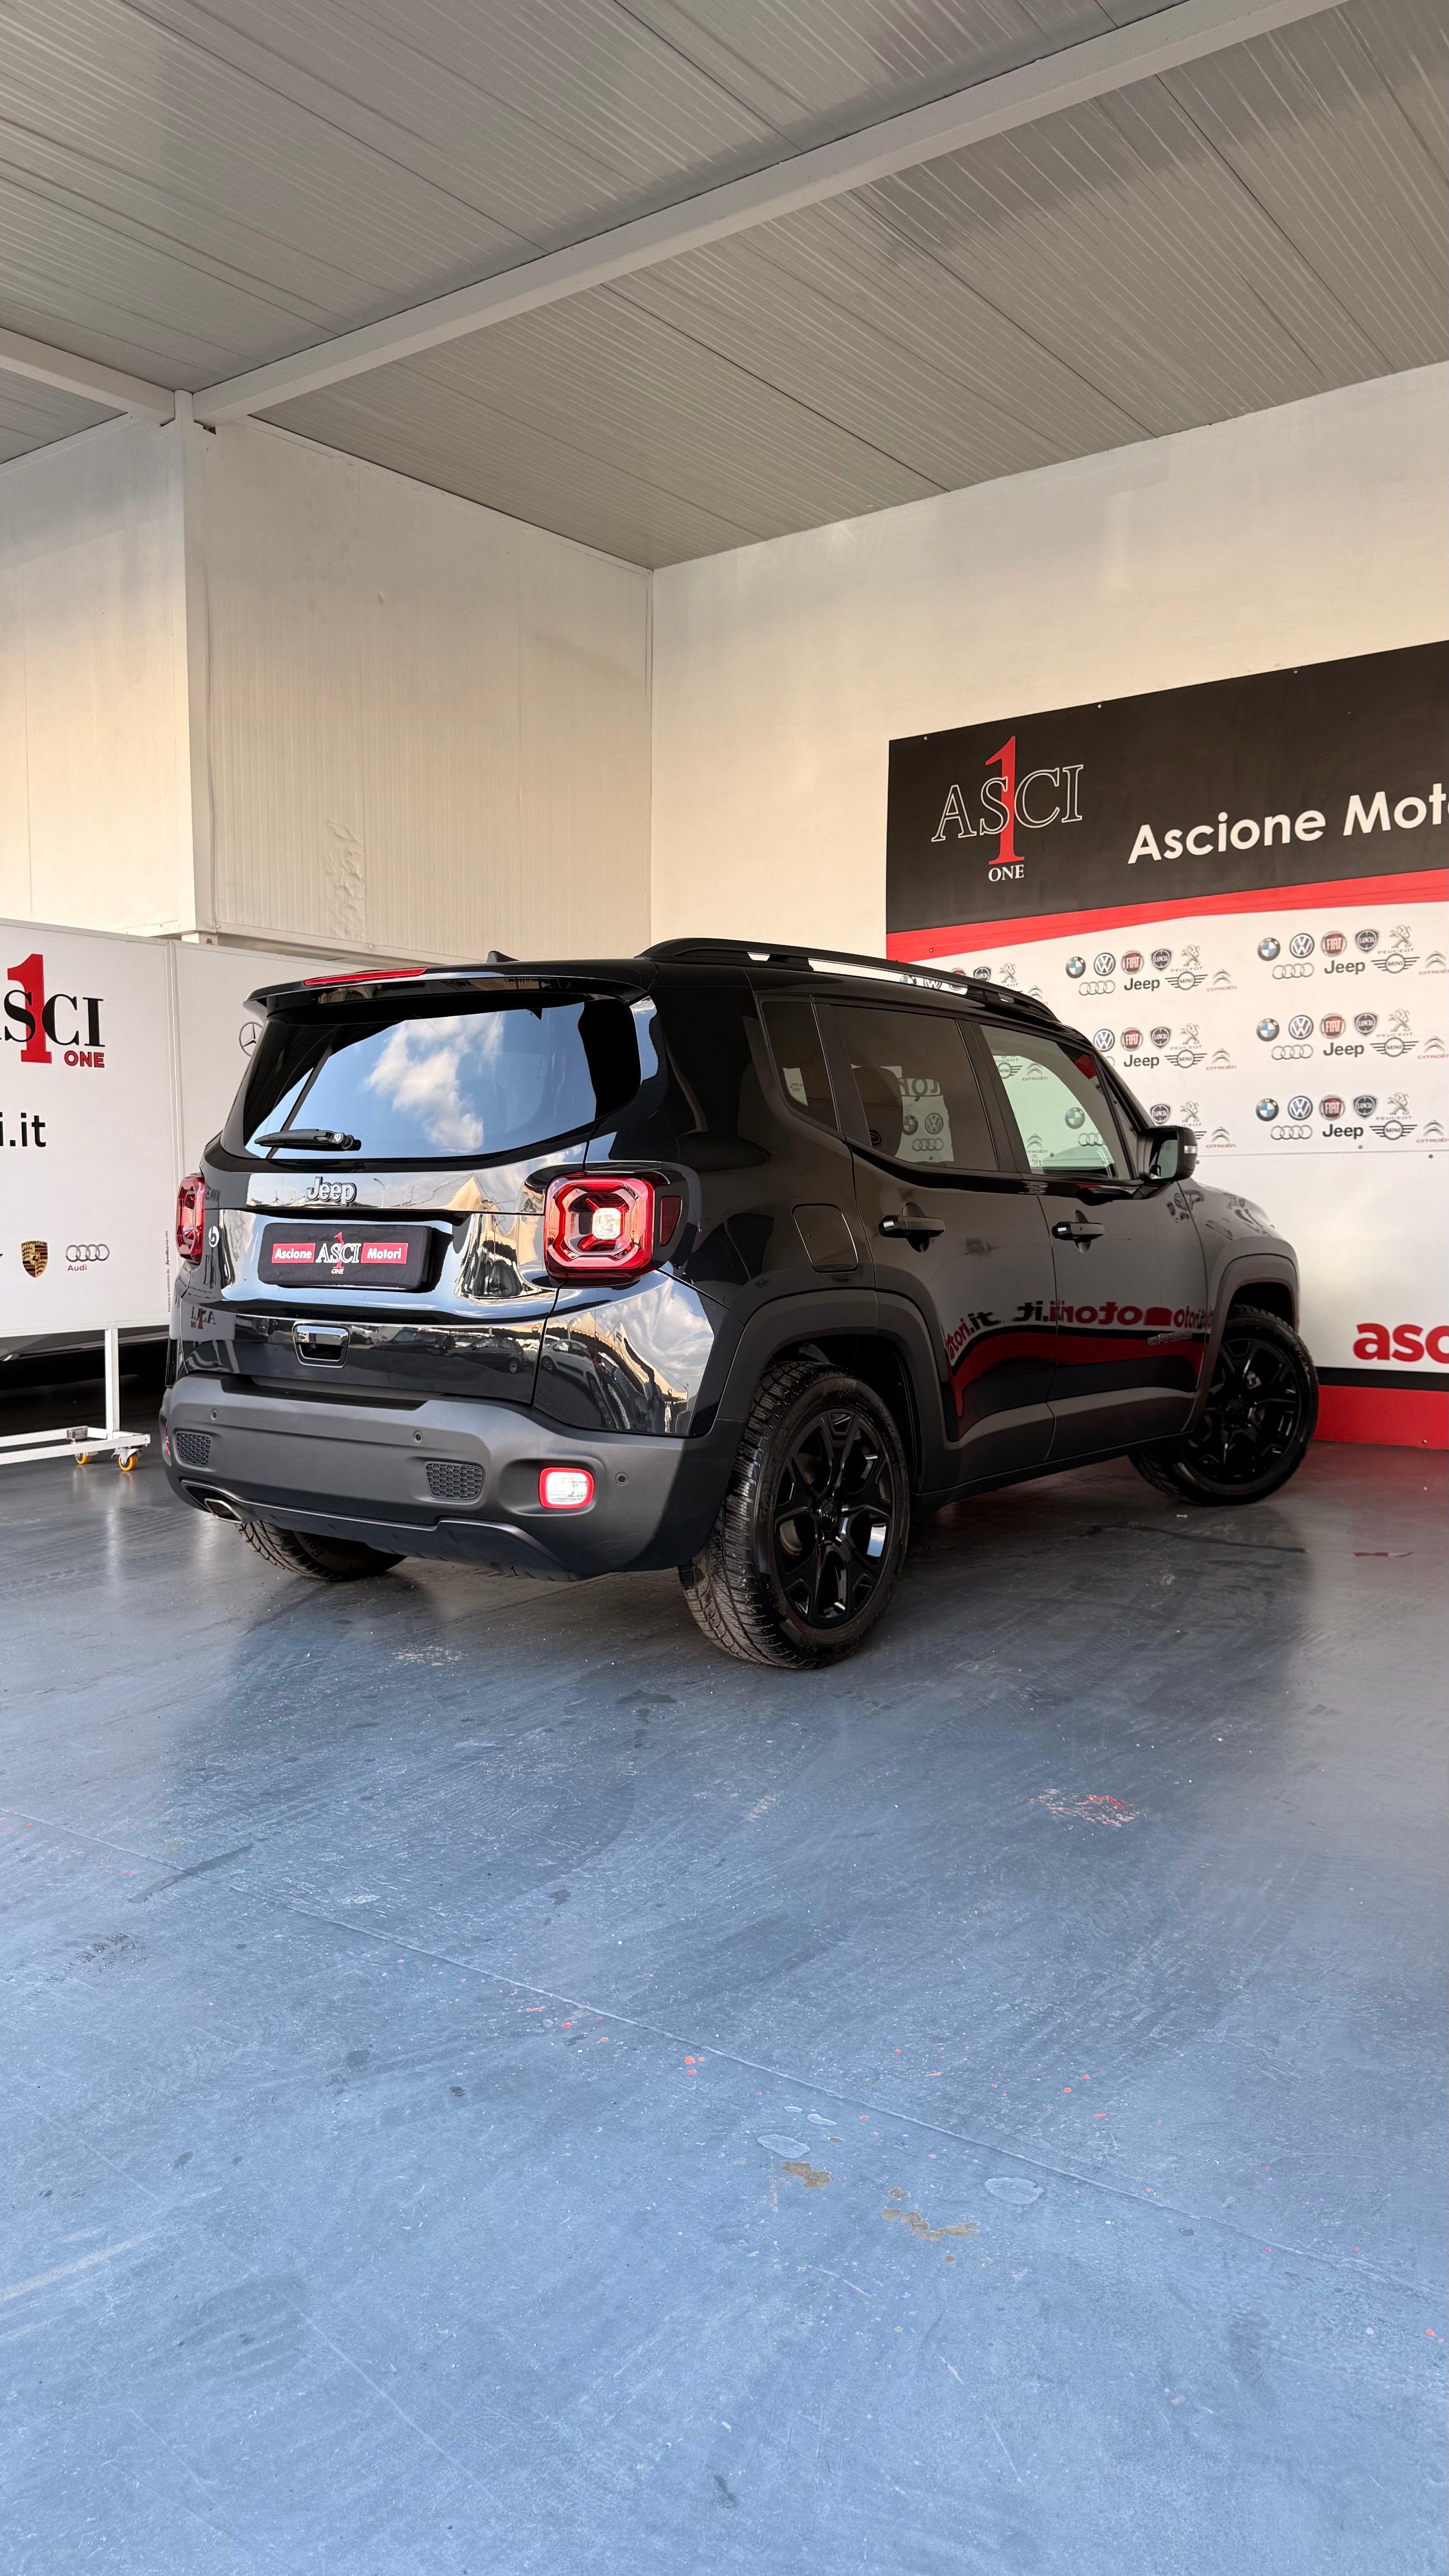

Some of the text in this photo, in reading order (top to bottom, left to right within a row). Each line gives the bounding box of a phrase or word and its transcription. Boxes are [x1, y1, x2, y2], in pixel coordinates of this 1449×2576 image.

[931, 764, 1084, 842] ASCI
[1127, 783, 1449, 864] Ascione Mot
[988, 864, 1024, 882] ONE
[1326, 938, 1342, 950] FIAT
[1125, 957, 1139, 969] FIAT
[1324, 960, 1365, 975] Jeep
[1124, 978, 1160, 991] Jeep
[0, 989, 106, 1047] SCI
[1326, 1020, 1341, 1033] FIAT
[1125, 1034, 1139, 1046] FIAT
[1323, 1043, 1364, 1058] Jeep
[64, 1050, 105, 1068] ONE
[1123, 1055, 1159, 1068] Jeep
[1325, 1102, 1340, 1114] FIAT
[1322, 1124, 1364, 1139] Jeep
[307, 1176, 357, 1206] Jeep
[274, 1242, 402, 1263] Ascione ASCI Motori
